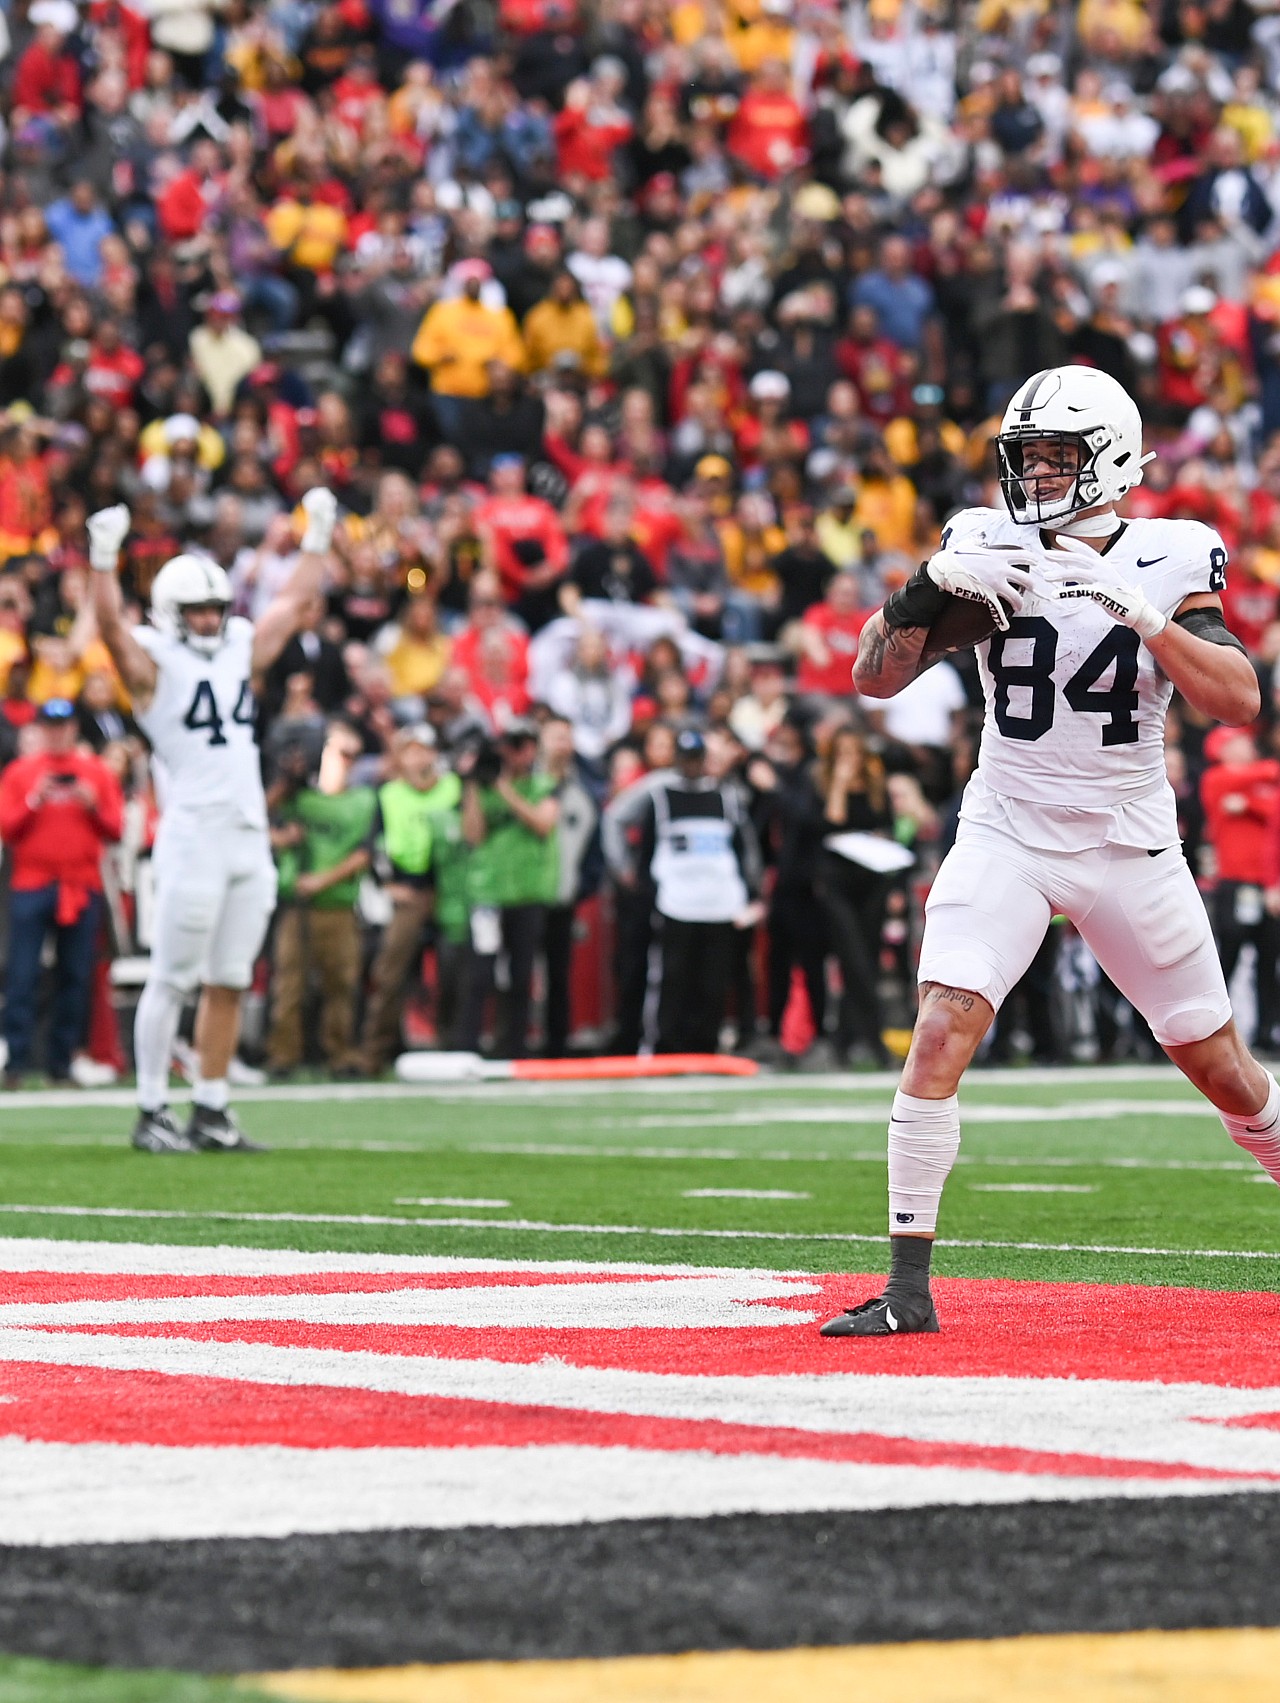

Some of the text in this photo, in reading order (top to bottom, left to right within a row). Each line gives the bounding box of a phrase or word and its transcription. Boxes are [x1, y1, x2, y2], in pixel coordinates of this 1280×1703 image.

[954, 586, 986, 602] PENN
[1094, 591, 1130, 618] STATE
[988, 615, 1140, 747] 84
[184, 680, 259, 746] 44
